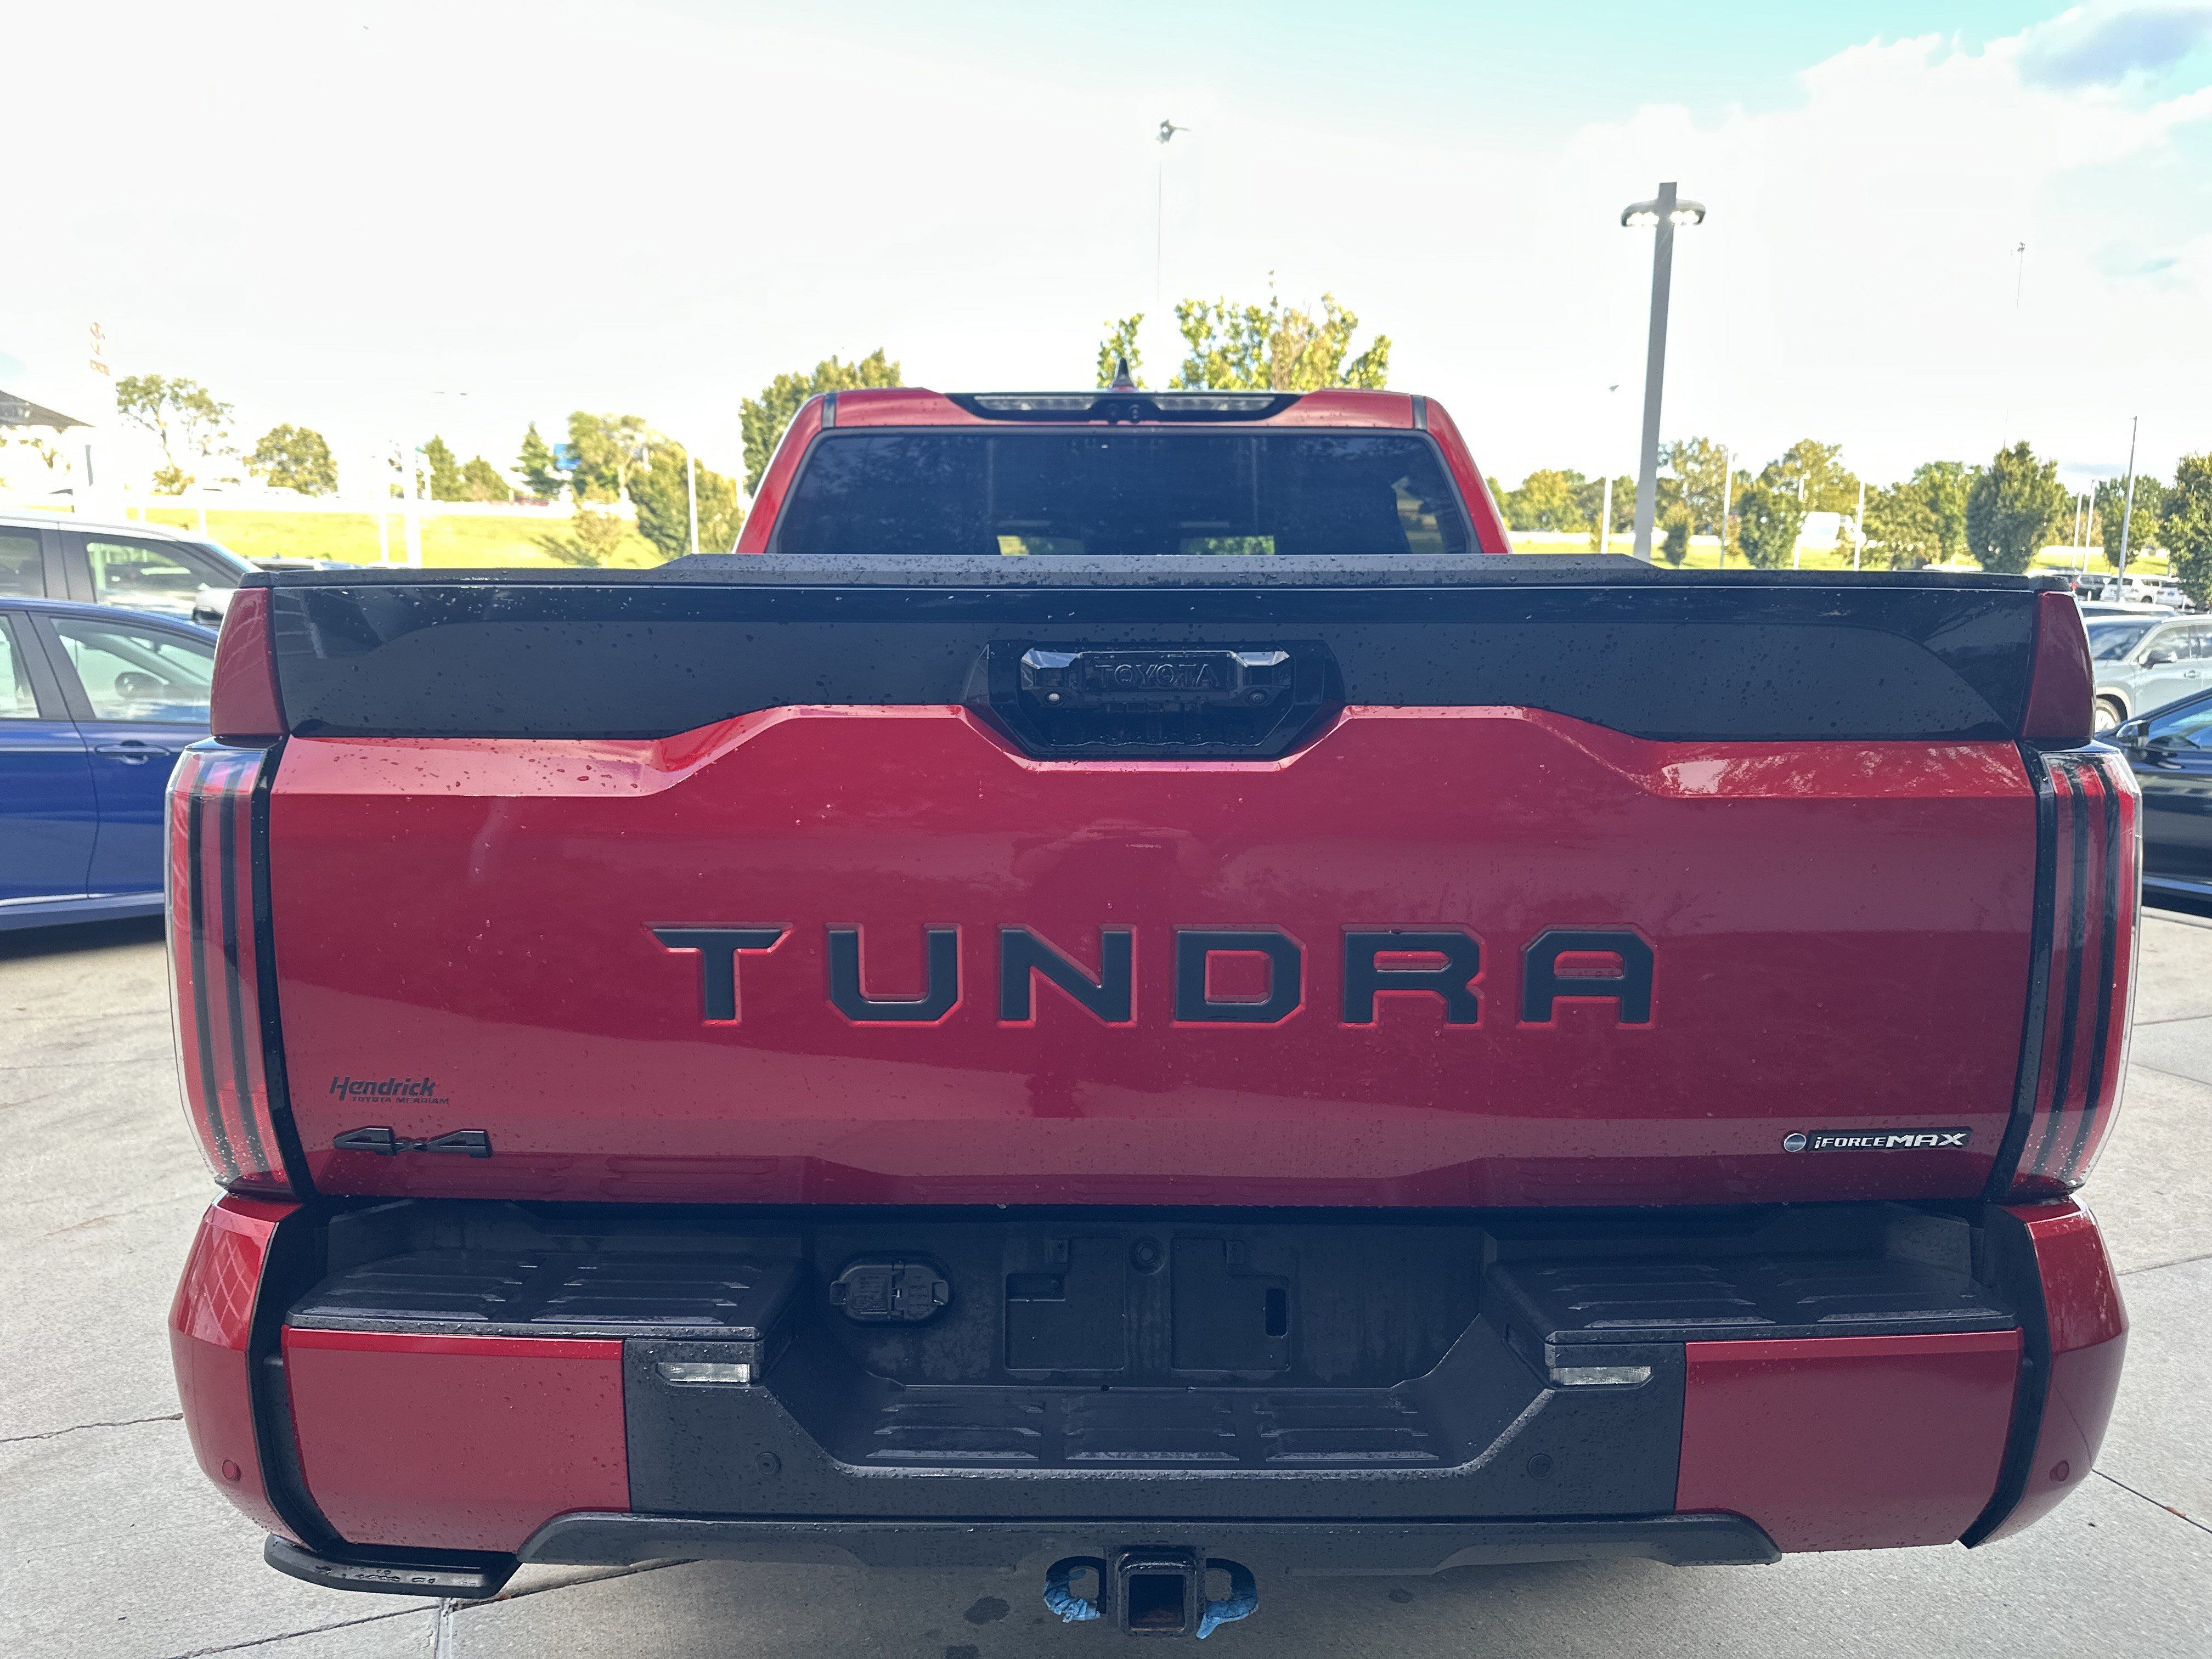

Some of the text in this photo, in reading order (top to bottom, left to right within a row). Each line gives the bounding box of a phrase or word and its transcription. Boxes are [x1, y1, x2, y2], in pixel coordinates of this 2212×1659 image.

[1094, 663, 1219, 687] TOYOTA
[647, 924, 1658, 1027] TUNDRA
[329, 1076, 436, 1101] Hendrick
